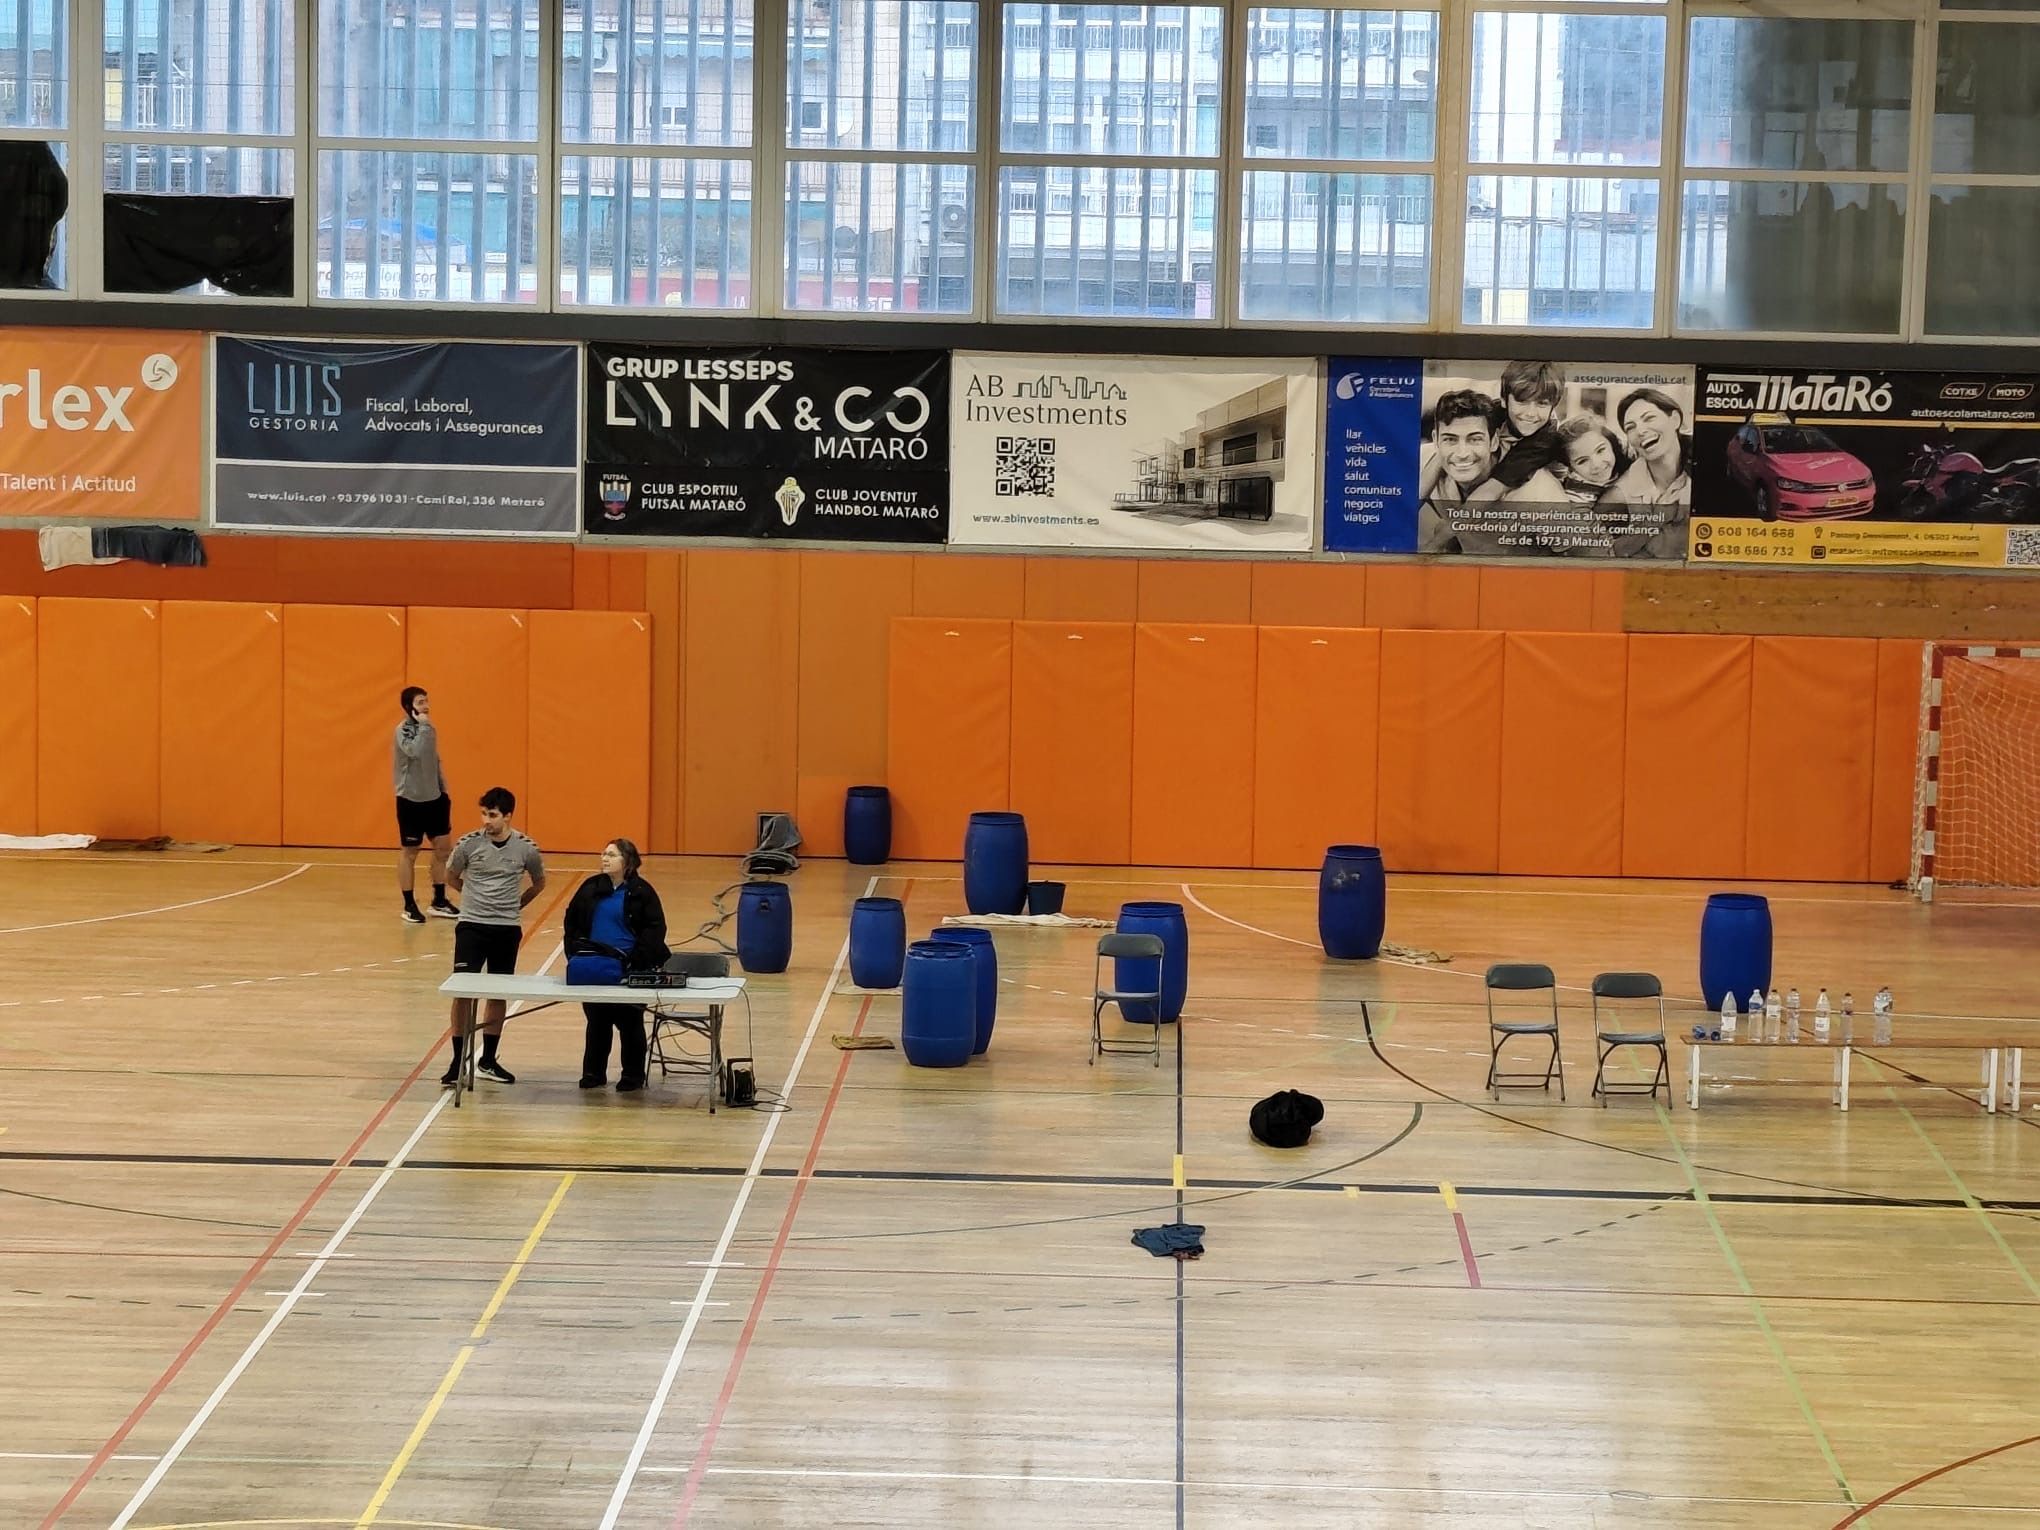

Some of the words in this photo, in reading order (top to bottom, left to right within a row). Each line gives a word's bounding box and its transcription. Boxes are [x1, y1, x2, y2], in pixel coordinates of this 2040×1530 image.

[607, 357, 679, 379] GRUP
[684, 359, 794, 381] LESSEPS
[966, 373, 1004, 397] AB
[1369, 377, 1415, 386] FELIU
[1573, 374, 1687, 386] assegurancesfeliu.cat
[248, 362, 341, 416] LUIS
[1945, 387, 1978, 397] COTXE
[1996, 388, 2026, 397] MOTO
[365, 397, 409, 415] Fiscal,
[414, 397, 474, 416] Laboral,
[606, 380, 782, 431] LYNK
[794, 396, 822, 432] &
[1706, 397, 1755, 410] ESCOLA
[966, 398, 1128, 426] Investments
[1911, 408, 2035, 419] autoescolamataro.com
[249, 417, 339, 432] GESTORIA
[364, 415, 432, 432] Advocats
[436, 417, 440, 432] i
[444, 418, 544, 437] Assegurances
[1346, 428, 1362, 439] llar
[814, 432, 929, 460] MATARÓ
[1345, 443, 1387, 454] vehicles
[1345, 457, 1367, 468] vida
[1344, 470, 1370, 481] salut
[0, 473, 56, 490] Talent
[62, 475, 66, 491] i
[72, 475, 136, 492] Actitud
[641, 483, 674, 495] CLUB
[678, 484, 738, 497] ESPORTIU
[815, 489, 848, 501] CLUB
[852, 490, 918, 503] JOVENTUT
[1344, 485, 1402, 496] comunitats
[247, 491, 327, 503] www.luis.cat
[641, 498, 685, 510] FUTSAL
[689, 496, 746, 512] MATARÓ
[1344, 499, 1384, 511] negocis
[815, 504, 880, 517] HANDBOL
[882, 505, 939, 519] MATARÓ
[1446, 508, 1470, 519] Tota
[1472, 508, 1482, 519] la
[1484, 510, 1518, 520] nostra
[1520, 509, 1580, 523] experiència
[1582, 511, 1593, 521] al
[1595, 512, 1628, 522] vostre
[972, 513, 1100, 526] www.abinvestments.es
[1344, 512, 1380, 525] viatges
[1451, 521, 1508, 533] Corredoria
[1510, 522, 1591, 536] d'assegurances
[1592, 523, 1607, 534] de
[1608, 524, 1660, 537] confiança
[1717, 526, 1742, 537] 608
[1746, 527, 1767, 538] 164
[1498, 535, 1517, 546] des
[1519, 535, 1533, 546] de
[1536, 536, 1562, 547] 1973
[1563, 538, 1569, 546] a
[1772, 546, 1795, 557] 732
